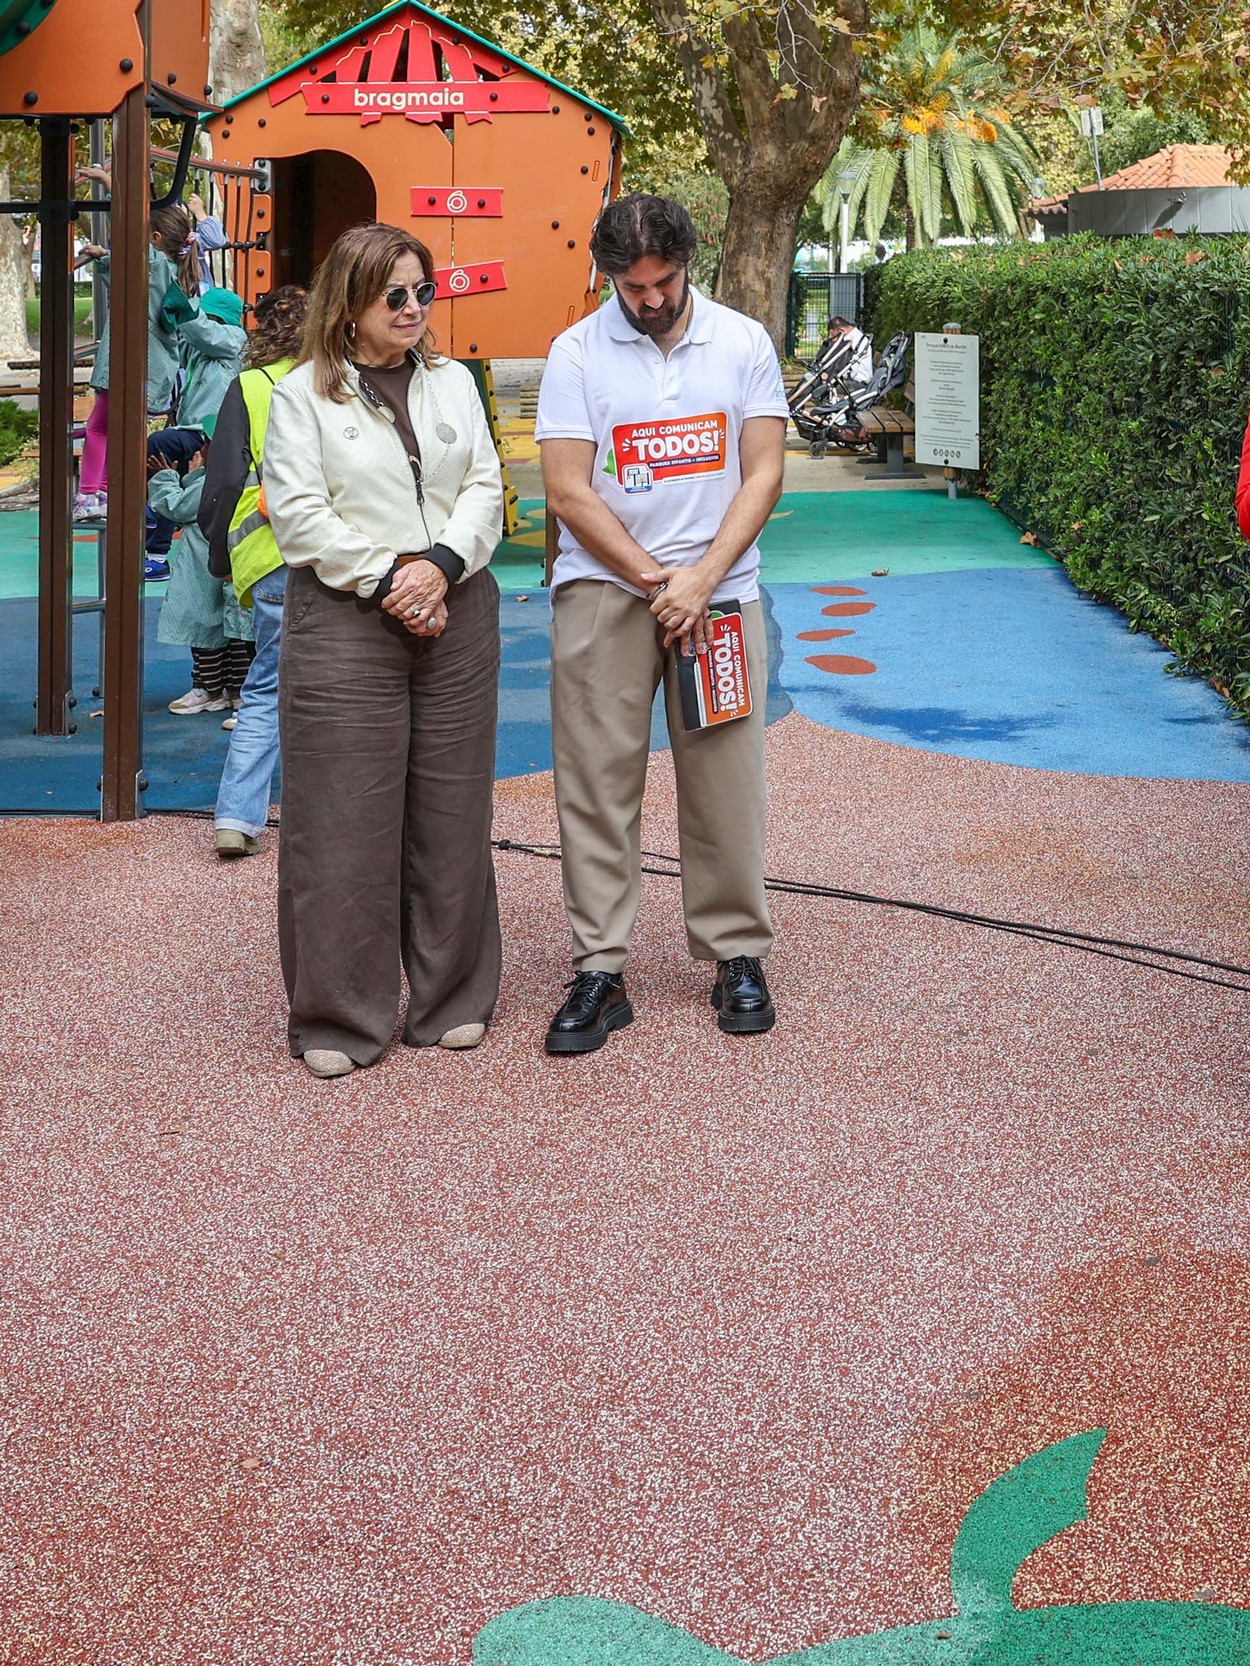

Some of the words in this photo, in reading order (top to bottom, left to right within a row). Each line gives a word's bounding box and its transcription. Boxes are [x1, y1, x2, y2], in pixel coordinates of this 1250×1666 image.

[354, 87, 464, 110] bragmaia
[632, 427, 655, 438] AQUI
[659, 420, 717, 434] COMUNICAM
[632, 431, 719, 460] TODOS!
[731, 631, 739, 652] AQUI
[713, 633, 737, 712] TODOS!
[734, 655, 745, 707] COMUNICAM
